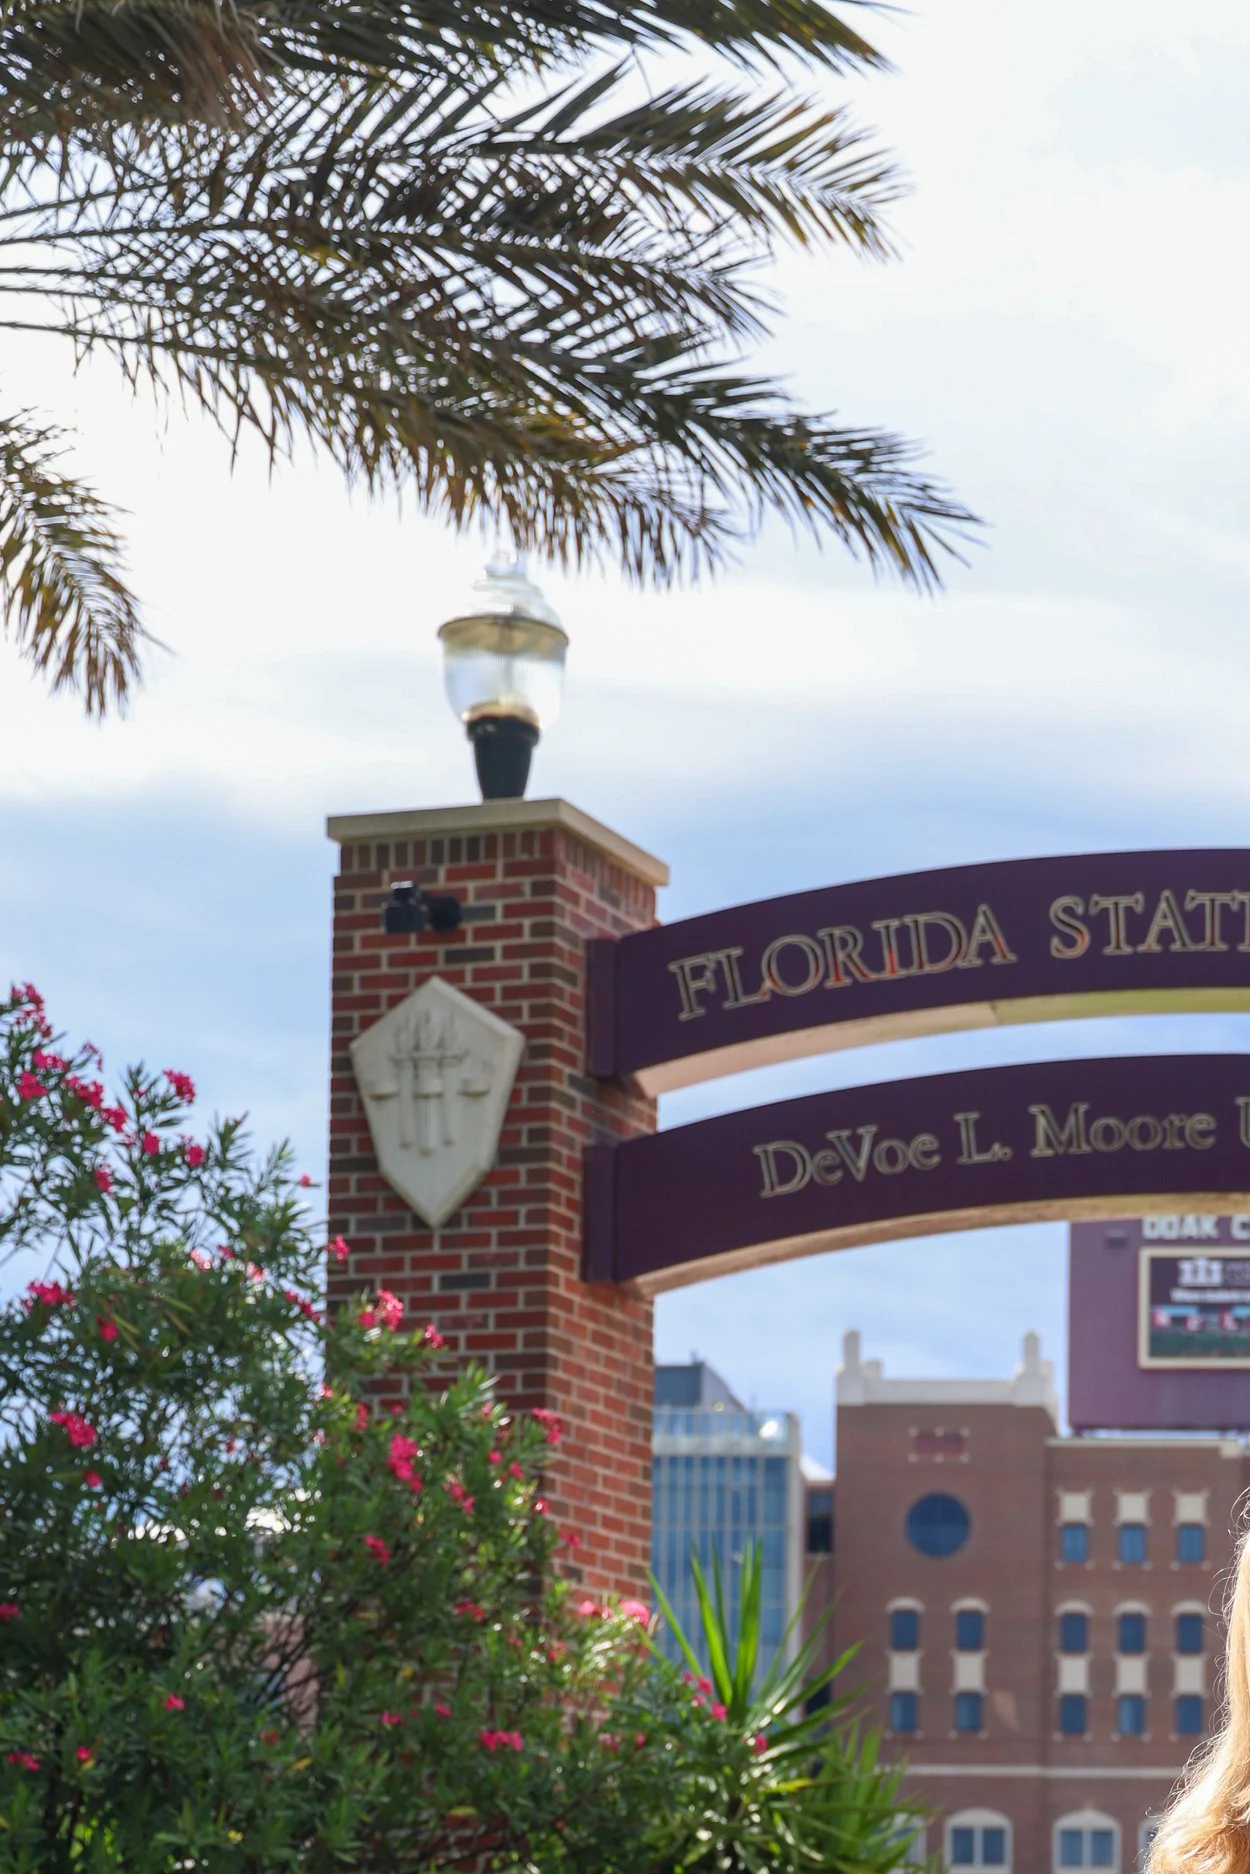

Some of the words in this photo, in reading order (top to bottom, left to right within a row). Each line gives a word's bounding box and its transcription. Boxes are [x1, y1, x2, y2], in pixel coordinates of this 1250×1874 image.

[668, 904, 1018, 1022] FLORIDA
[753, 1125, 941, 1198] DeVoe
[954, 1112, 1012, 1165] L.
[1029, 1102, 1217, 1159] Moore
[1142, 1214, 1220, 1240] DOAK
